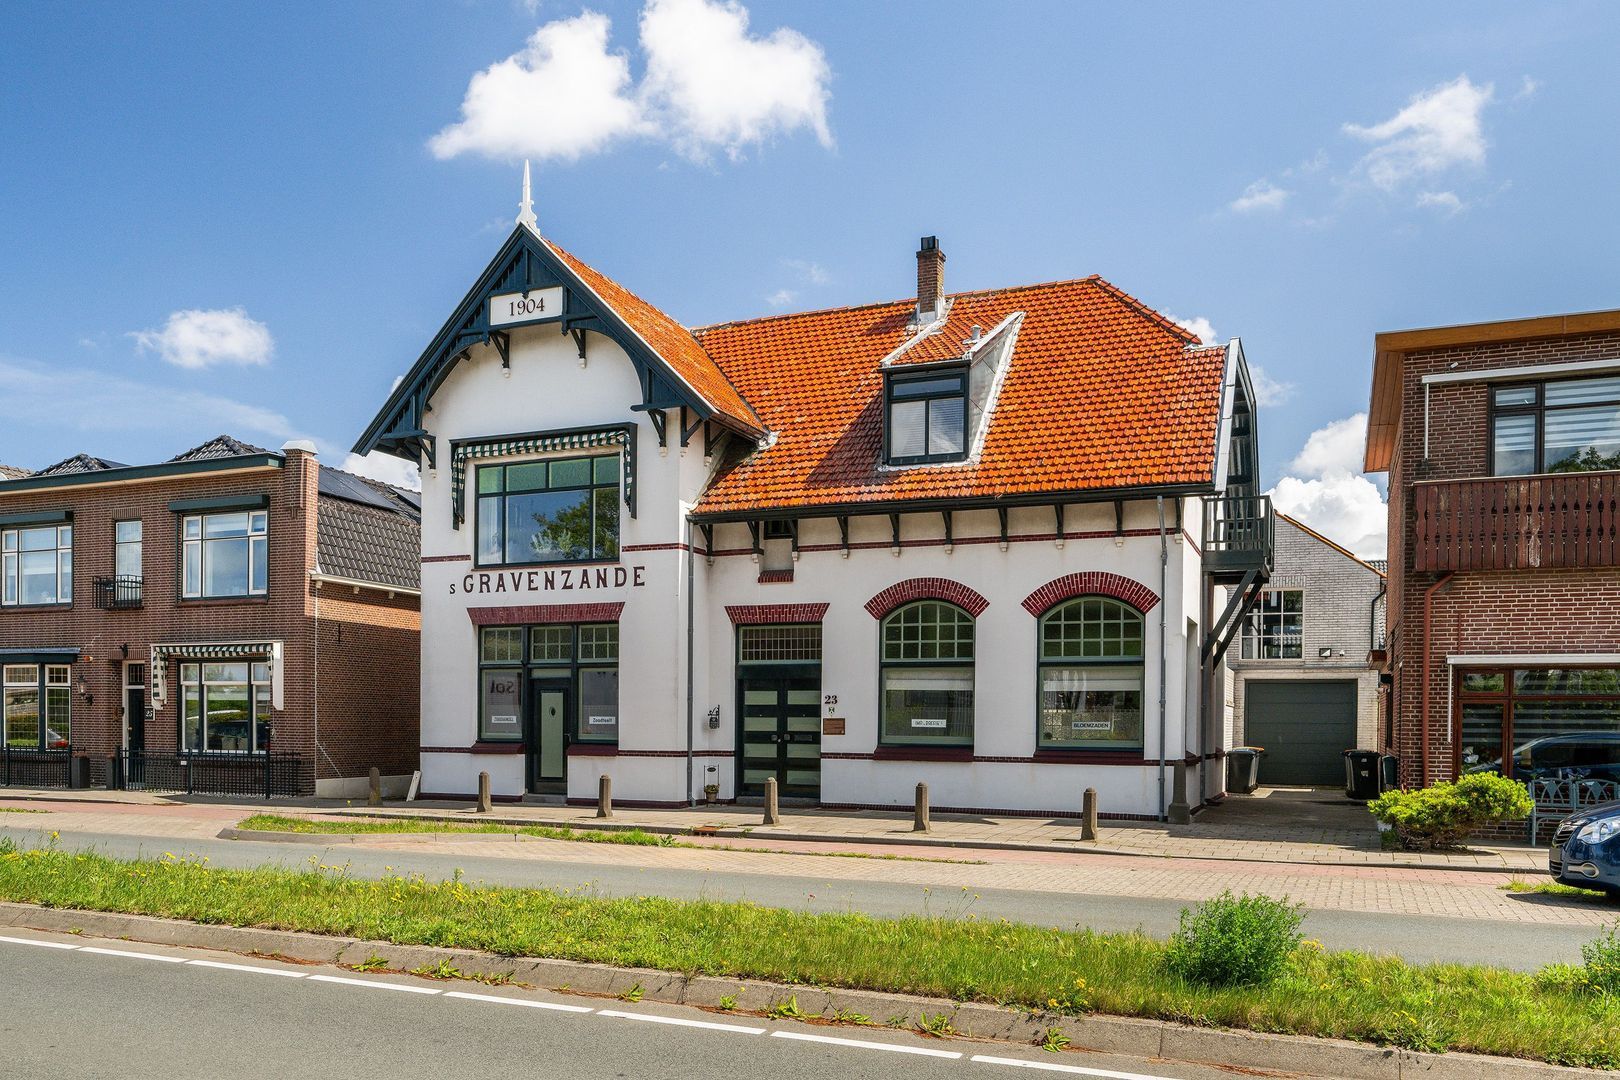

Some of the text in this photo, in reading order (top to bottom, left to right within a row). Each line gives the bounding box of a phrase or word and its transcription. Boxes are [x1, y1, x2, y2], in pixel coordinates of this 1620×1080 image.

[509, 297, 545, 317] 1904
[462, 566, 646, 594] GRAVENZANDE
[824, 694, 838, 704] 23
